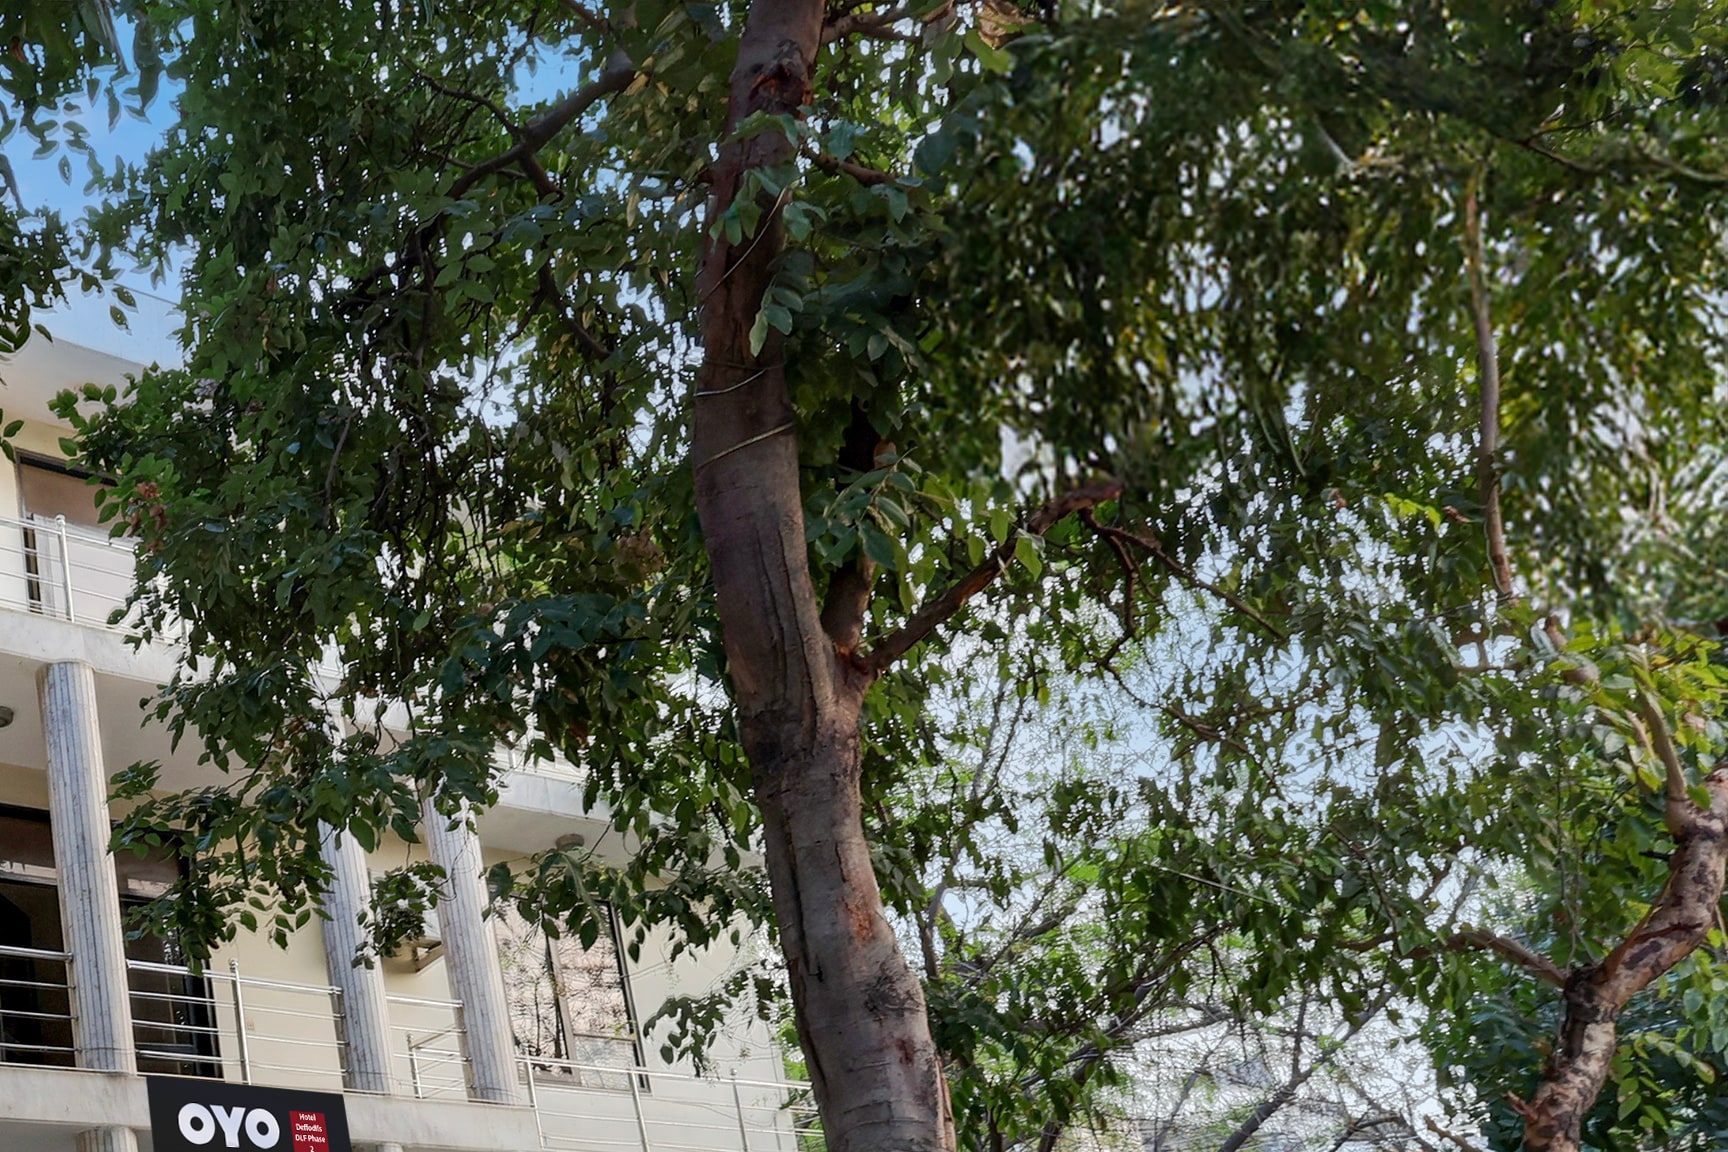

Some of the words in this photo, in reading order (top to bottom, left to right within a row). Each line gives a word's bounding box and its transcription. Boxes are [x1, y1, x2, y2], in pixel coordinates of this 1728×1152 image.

[299, 1113, 316, 1121] Hotel
[178, 1102, 280, 1149] OYO
[307, 1135, 326, 1143] Phase
[309, 1145, 315, 1152] 2
